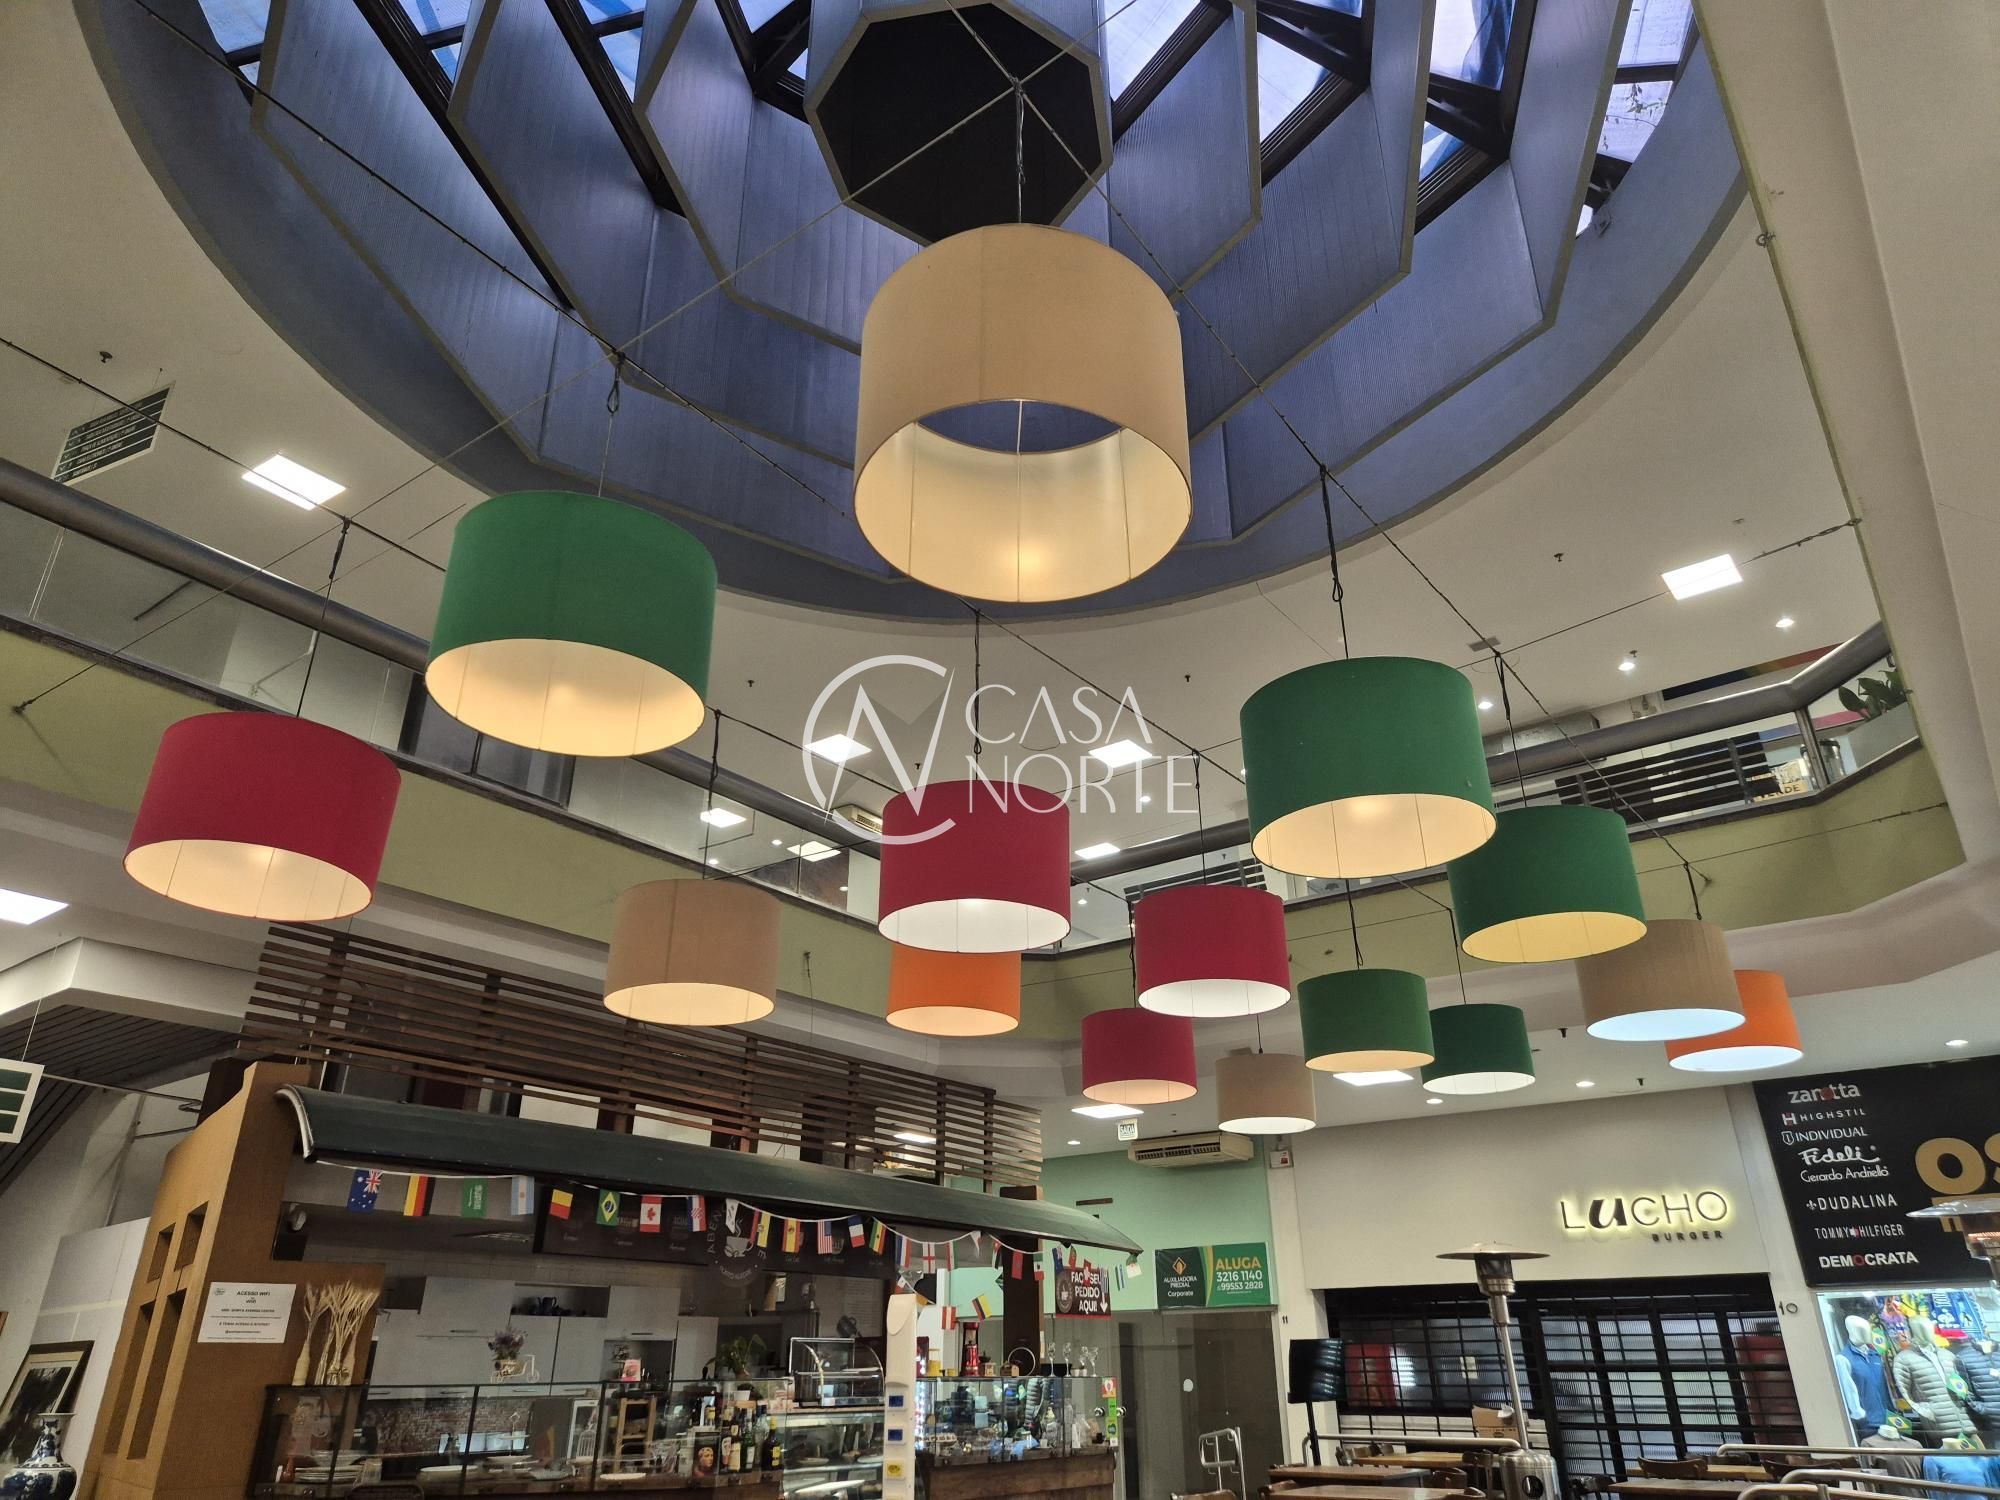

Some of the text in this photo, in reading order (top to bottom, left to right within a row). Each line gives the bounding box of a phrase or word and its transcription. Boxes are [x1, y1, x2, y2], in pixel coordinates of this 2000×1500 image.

[1800, 1108, 1866, 1122] HIGHSTIL
[1795, 1127, 1868, 1142] INDIVIDUAL
[1914, 1132, 2000, 1195] O
[1800, 1168, 1843, 1183] Gerardo
[1817, 1193, 1899, 1211] DUDALINA
[1651, 1230, 1724, 1243] BURGER
[1814, 1223, 1905, 1240] TOMMY HILFIGER
[1215, 1256, 1262, 1271] ALUGA
[1819, 1251, 1919, 1269] DEMOCRATA
[1216, 1269, 1263, 1283] 3216 1140
[1074, 1285, 1100, 1299] PEDIDO
[1221, 1280, 1264, 1291] 99553 2828
[1167, 1290, 1194, 1299] Corporate
[1779, 1301, 1798, 1316] 10
